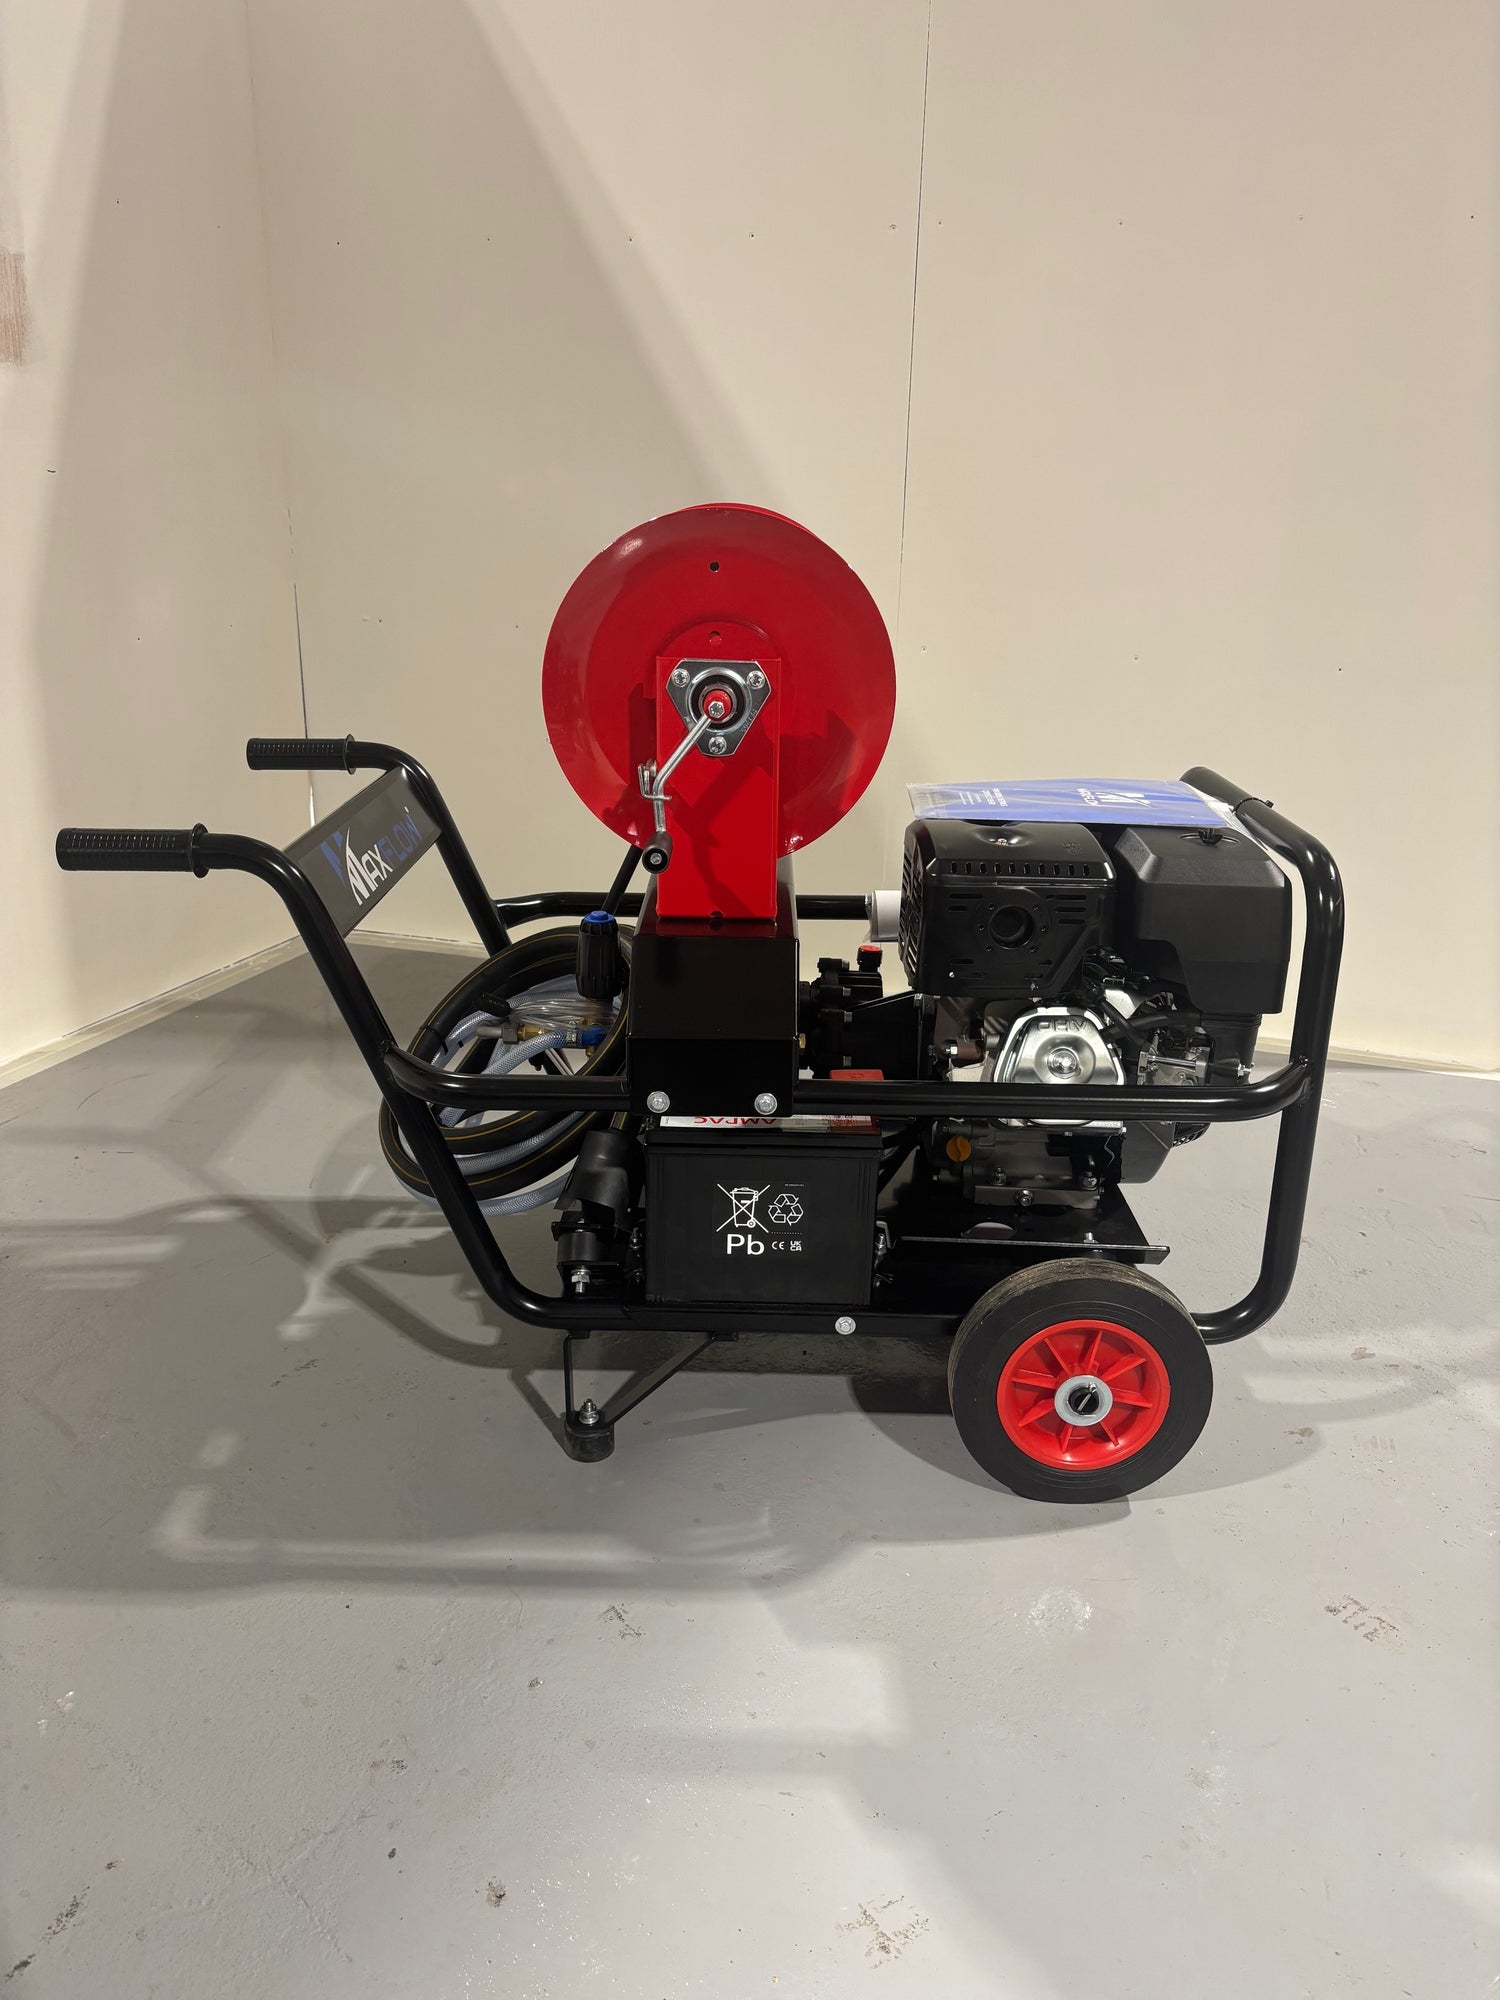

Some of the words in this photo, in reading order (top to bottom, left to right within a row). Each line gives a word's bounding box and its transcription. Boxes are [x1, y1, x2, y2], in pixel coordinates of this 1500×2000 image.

[1037, 1019, 1088, 1032] OHV
[726, 1233, 765, 1256] Pb
[771, 1240, 785, 1250] CE
